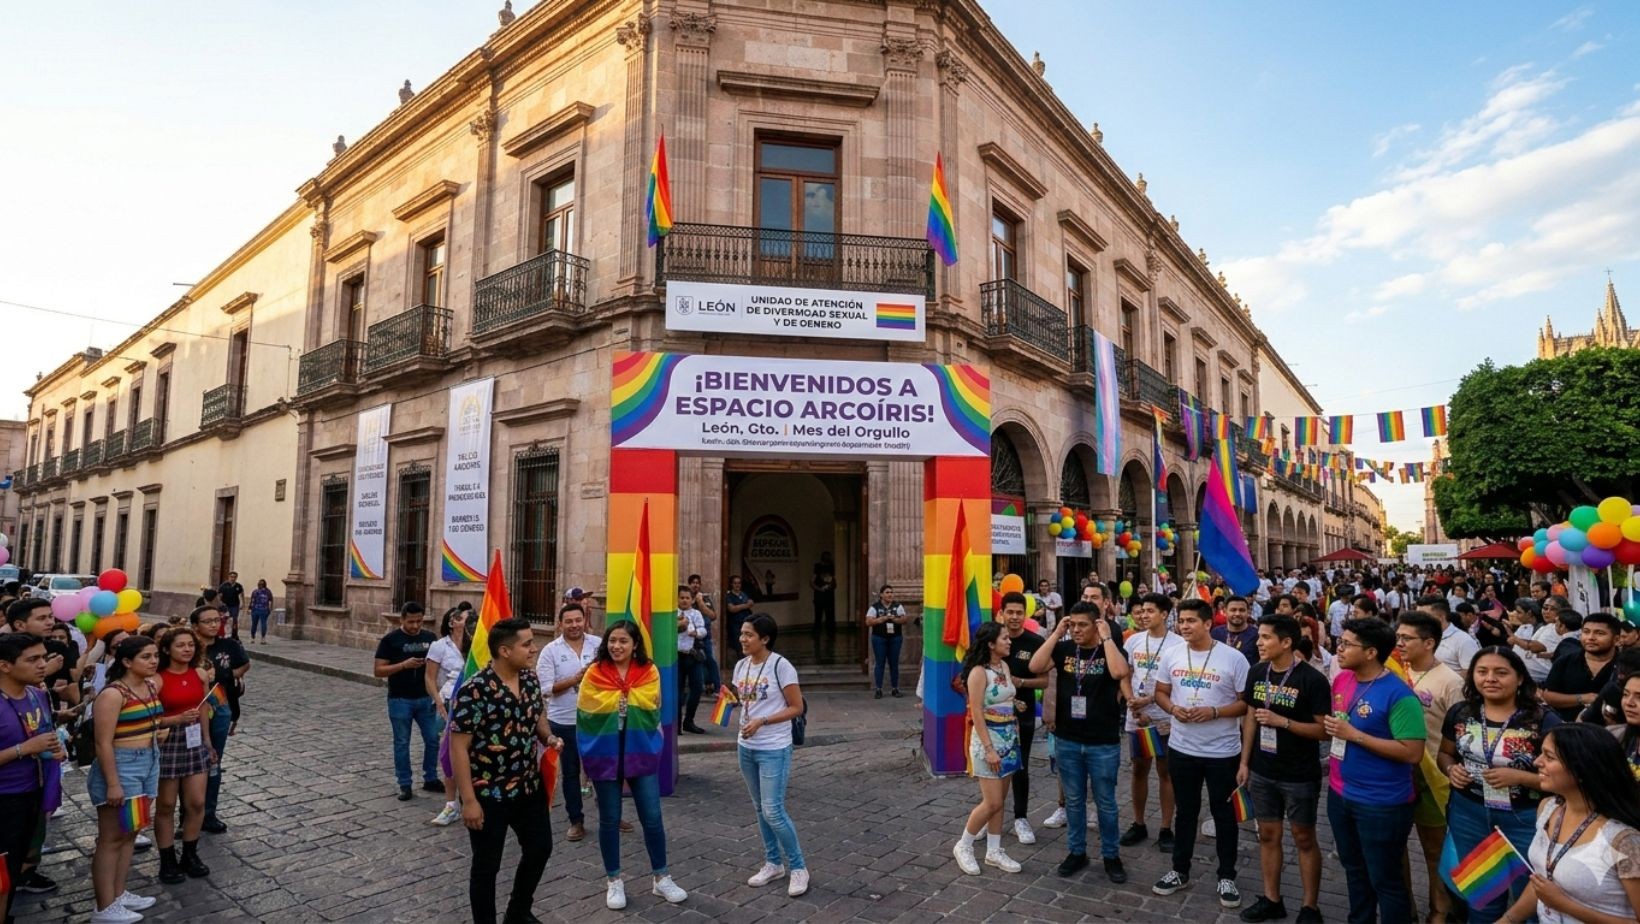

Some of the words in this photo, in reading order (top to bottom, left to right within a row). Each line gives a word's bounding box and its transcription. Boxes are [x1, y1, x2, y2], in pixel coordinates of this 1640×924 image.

[698, 299, 736, 313] LEÓN
[794, 297, 809, 307] DE
[812, 298, 863, 309] ATENCIÓN
[746, 306, 761, 316] DE
[828, 310, 869, 320] SEXUAL
[773, 317, 782, 327] Y
[783, 318, 798, 328] DE
[695, 371, 893, 396] ¡BIENVENIDOS
[898, 378, 919, 398] A
[675, 396, 794, 419] ESPACIO
[799, 397, 935, 424] ARCOÍRIS!
[701, 421, 744, 436] León,
[747, 422, 780, 436] Gto.
[792, 424, 824, 437] Mes
[826, 424, 851, 438] del
[854, 425, 911, 442] Orgullo
